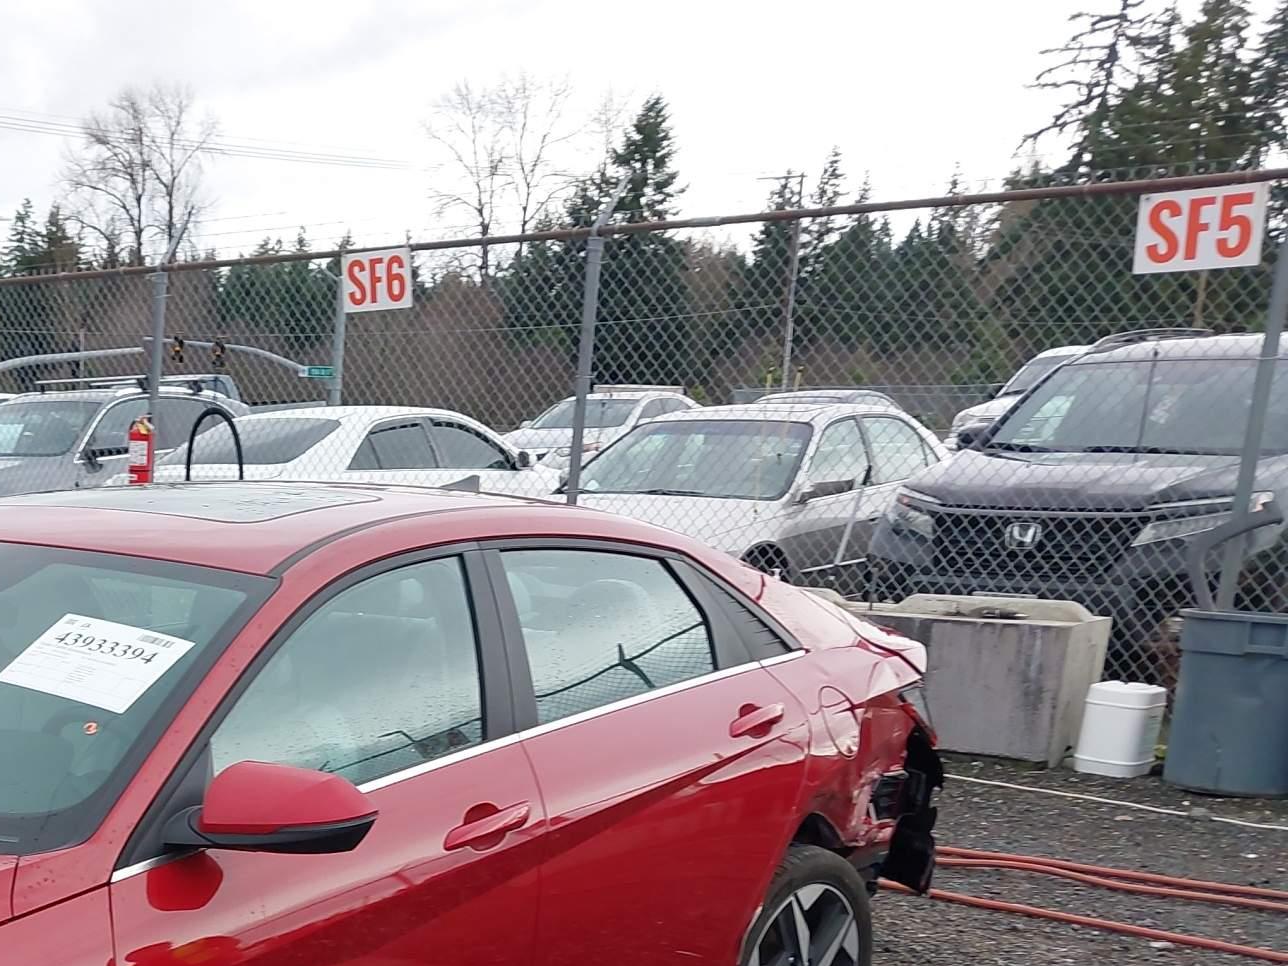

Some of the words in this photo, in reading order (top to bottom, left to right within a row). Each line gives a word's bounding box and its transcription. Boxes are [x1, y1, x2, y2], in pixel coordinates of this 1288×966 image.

[1145, 191, 1255, 264] SF5
[347, 254, 406, 306] SF6
[54, 631, 159, 665] 43933394
